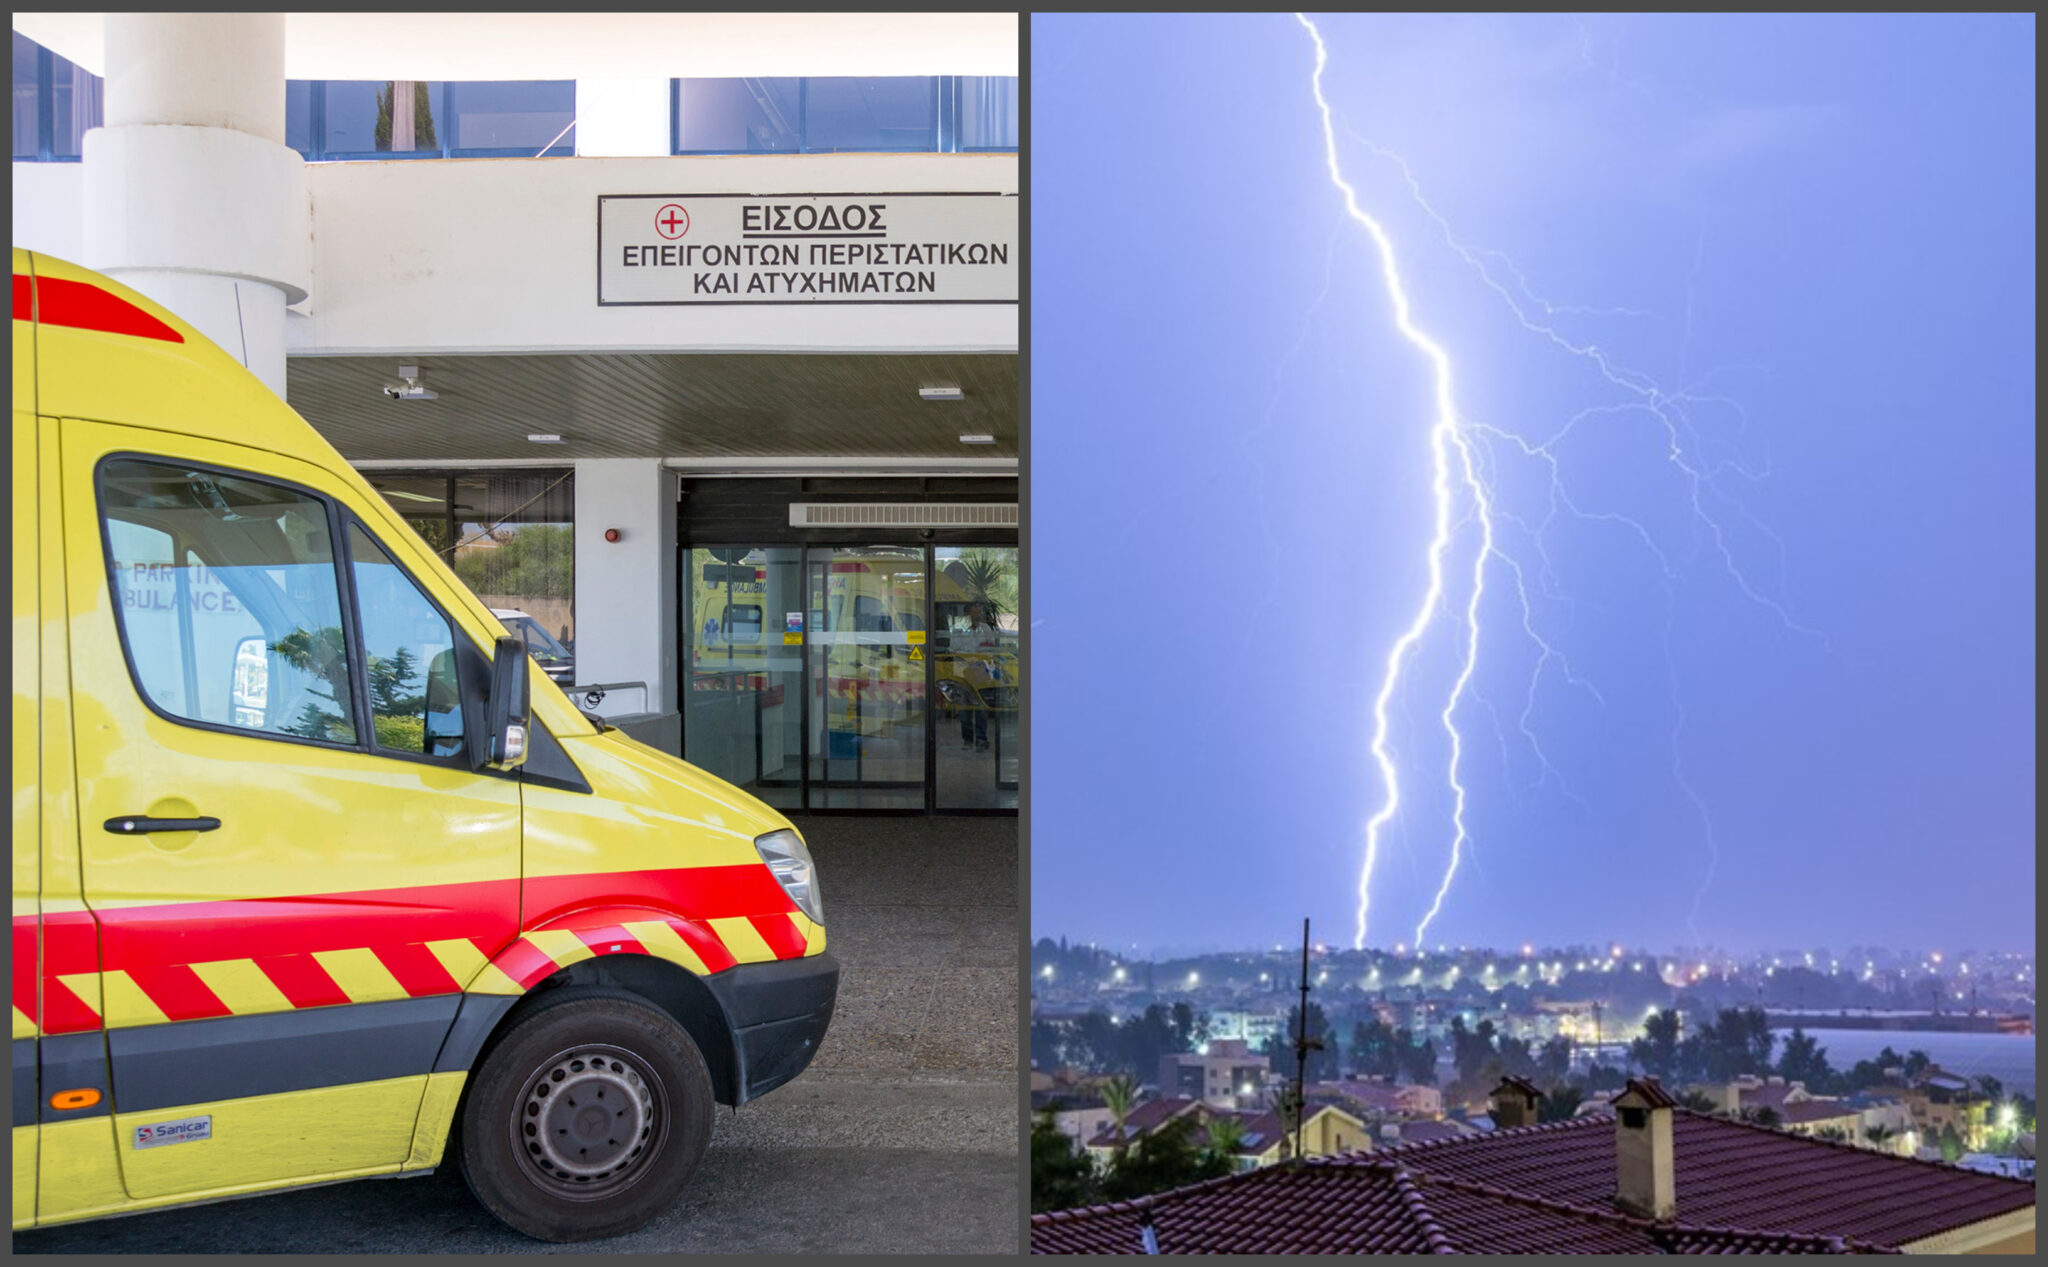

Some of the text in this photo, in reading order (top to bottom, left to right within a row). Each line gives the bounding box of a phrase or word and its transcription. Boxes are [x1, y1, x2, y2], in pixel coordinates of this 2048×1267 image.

[742, 205, 886, 231] ΕΙΣΟΔΟΣ
[623, 244, 1008, 266] ΕΠΕΙΓΟΝΤΩΝ ΠΕΡΙΣΤΑΤΙΚΩΝ
[694, 272, 935, 293] ΚΑΙ ΑΤΥΧΗΜΑΤΩΝ
[134, 563, 221, 584] PARIN
[125, 590, 236, 612] BULNCE
[157, 1121, 208, 1136] Sanicar
